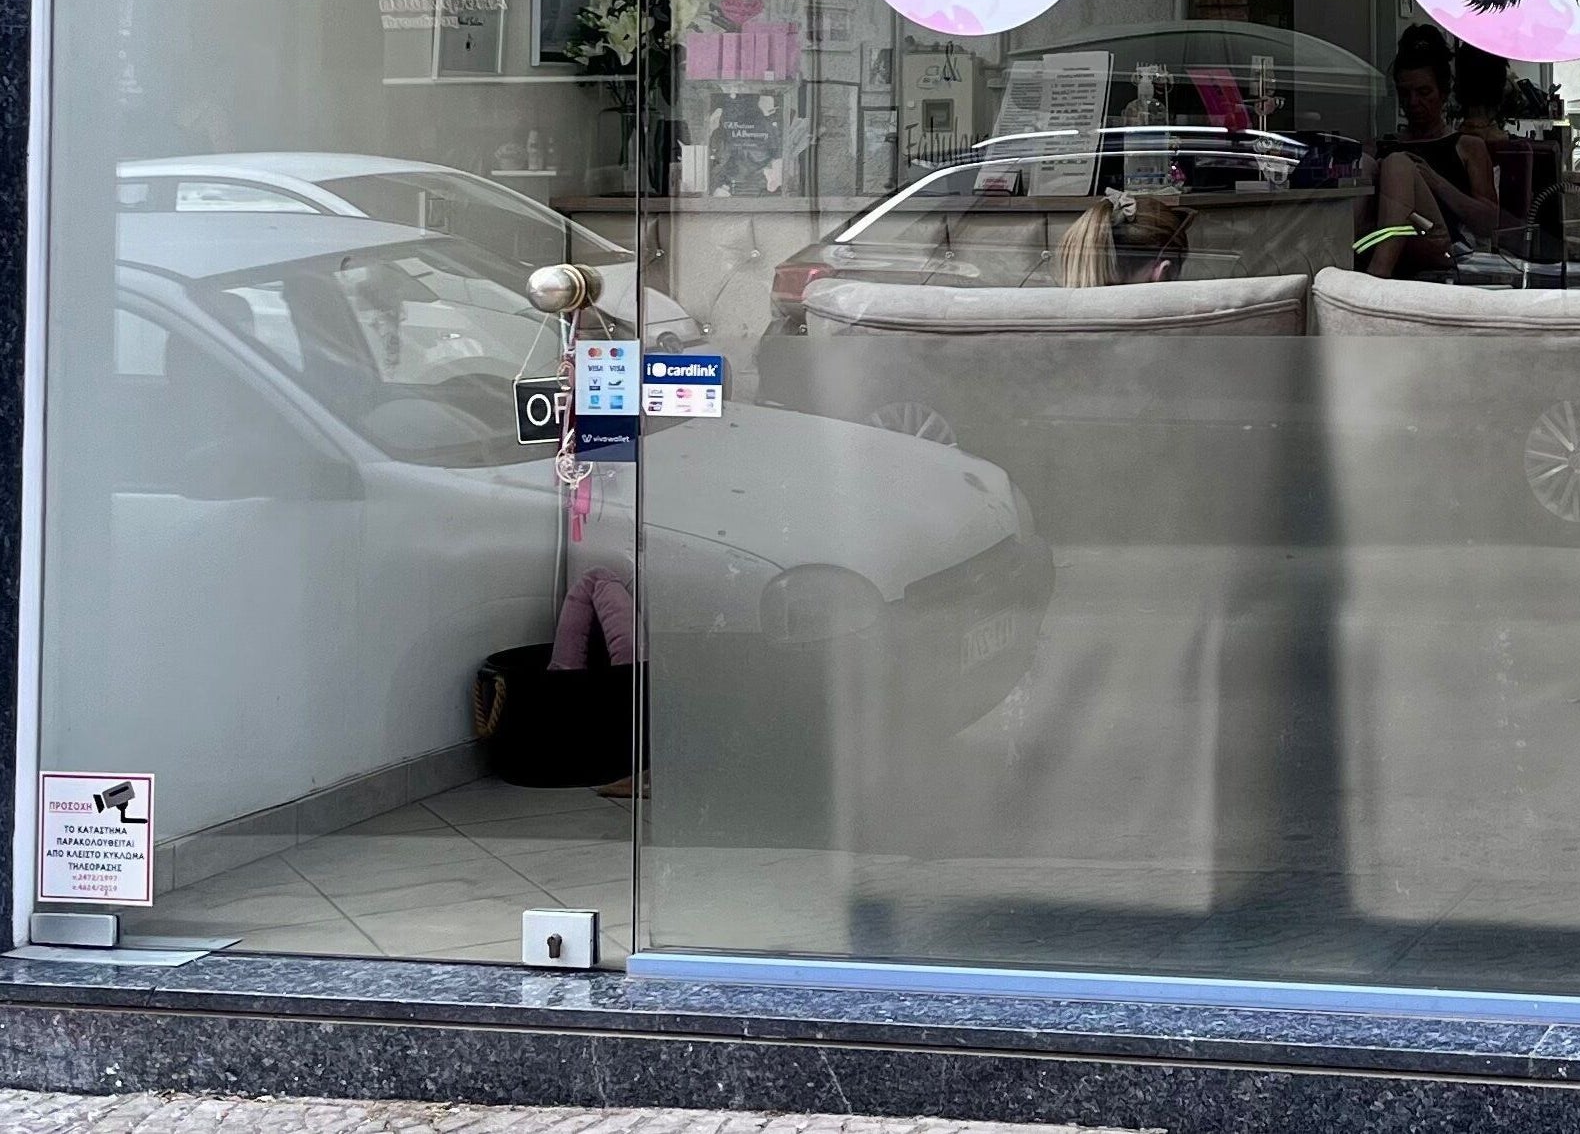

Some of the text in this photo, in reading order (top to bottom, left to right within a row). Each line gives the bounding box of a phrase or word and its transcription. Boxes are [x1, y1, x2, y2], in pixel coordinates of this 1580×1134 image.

[667, 363, 716, 377] cardlink
[526, 392, 572, 426] OF
[49, 801, 93, 811] ΠΡΟΣΟΧΗ
[64, 825, 127, 835] ΤΟ ΚΑΤΑΣΤΗΜΑ
[46, 849, 144, 860] ΑΠΟ ΚΛΕΙΣΤΟ ΚΥΚΛΩΜΑ
[68, 862, 122, 872] ΤΗΛΕΟΡΑΣΗΣ
